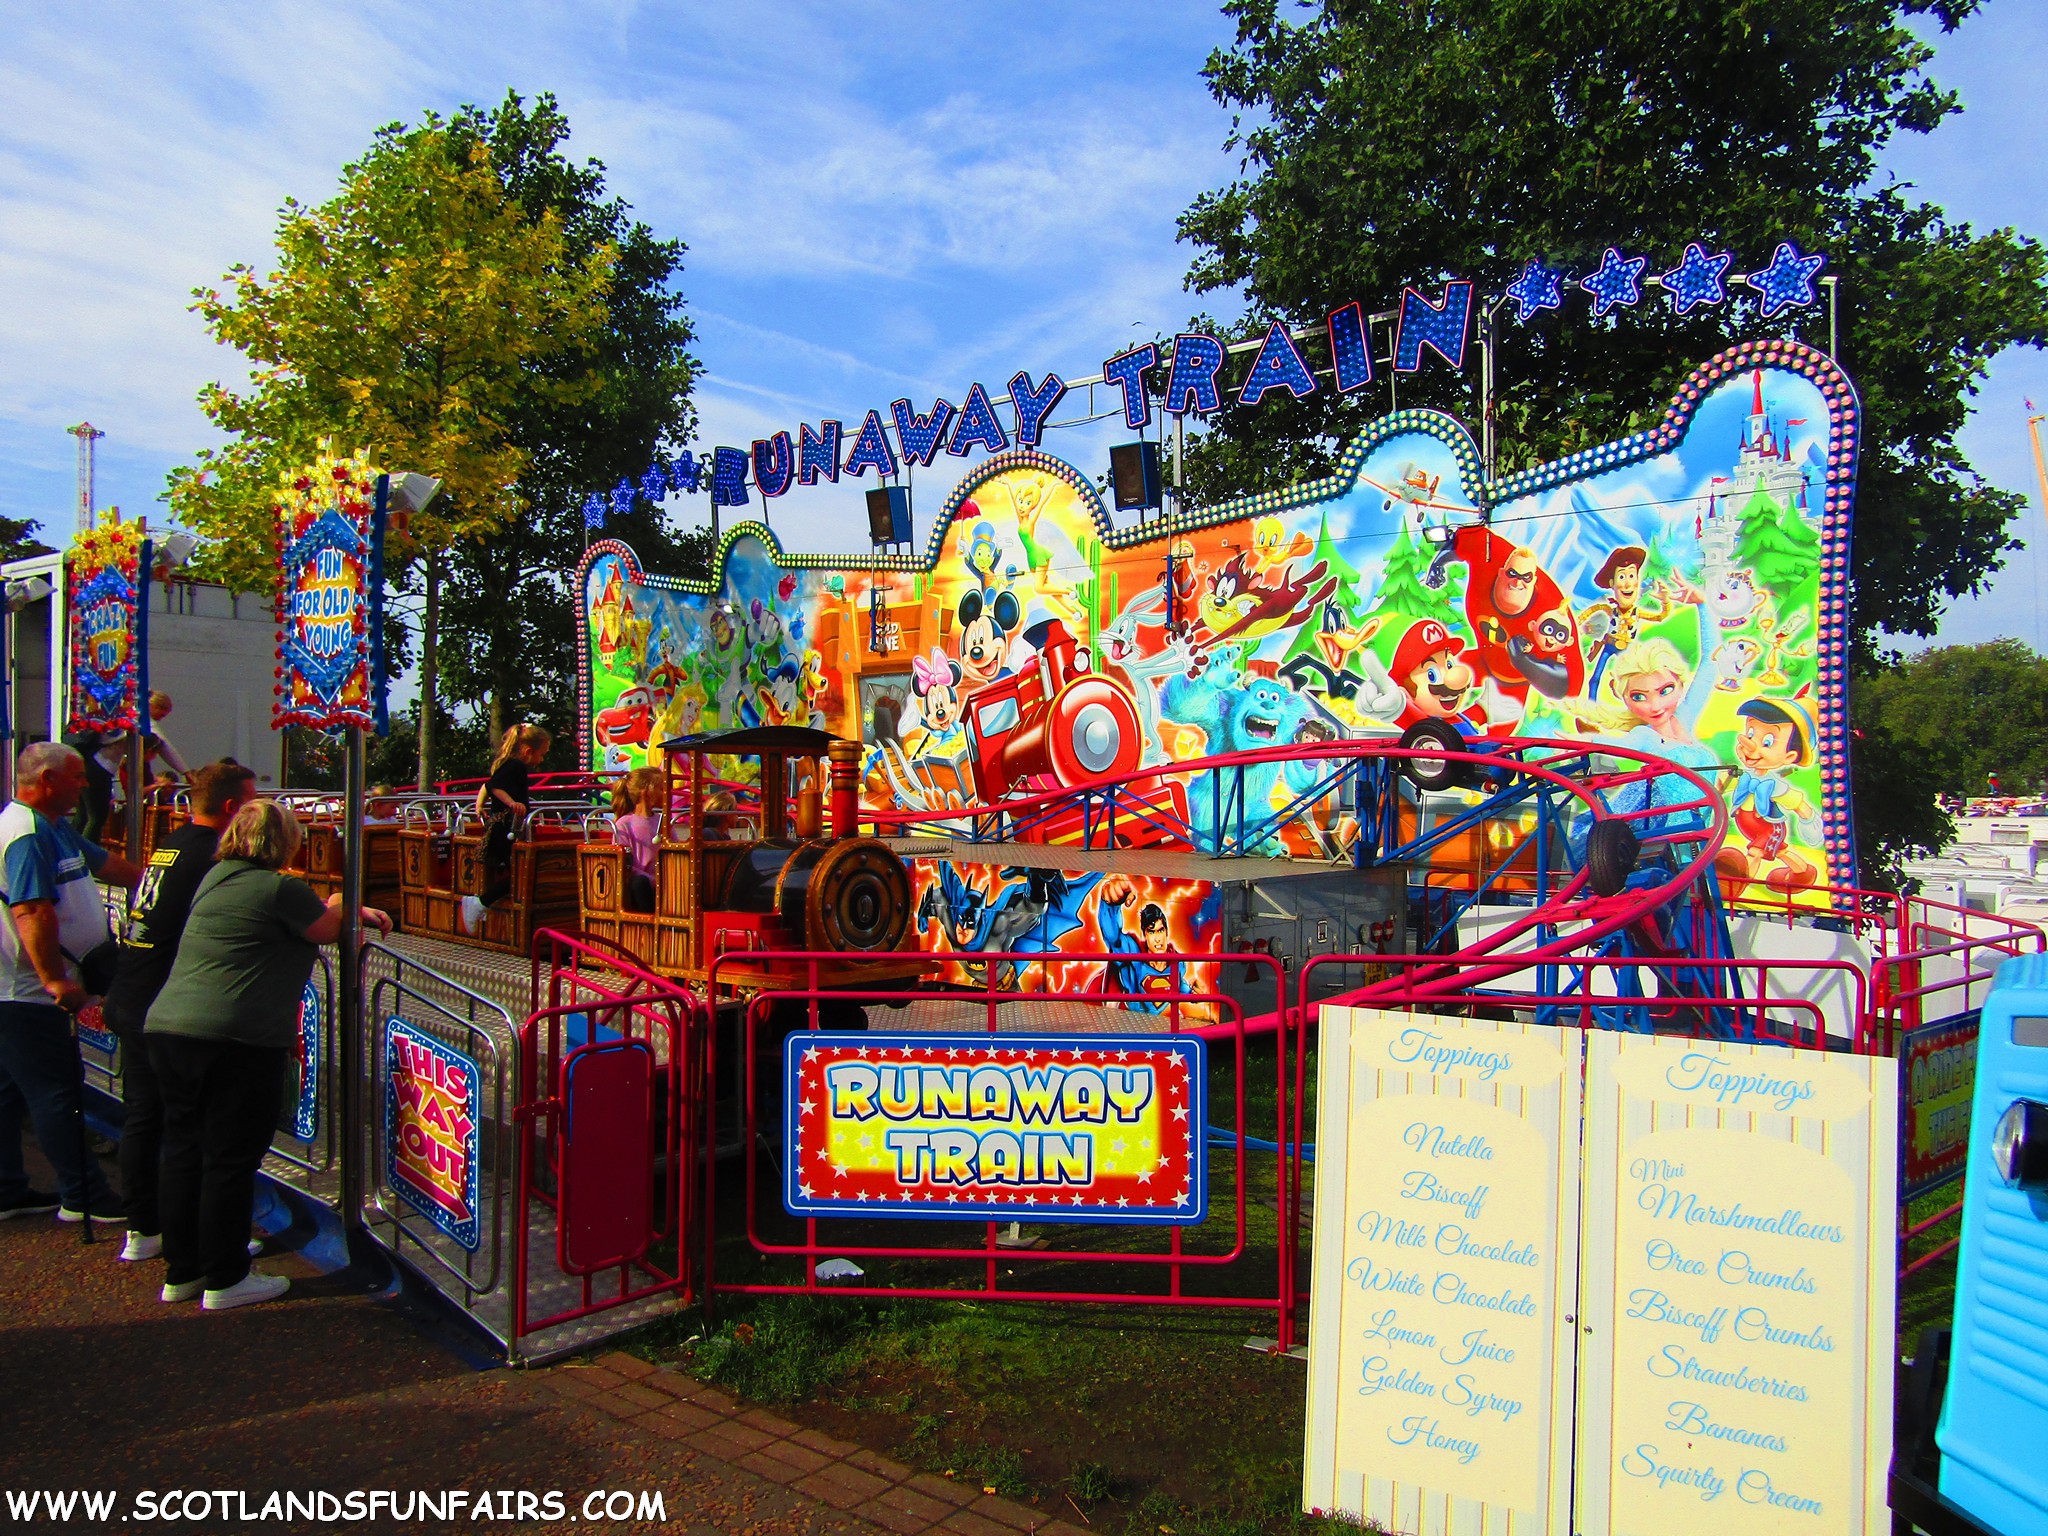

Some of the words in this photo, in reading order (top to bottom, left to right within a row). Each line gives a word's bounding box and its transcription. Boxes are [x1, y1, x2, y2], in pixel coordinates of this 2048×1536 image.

[711, 370, 1070, 506] RUNAWAY
[1103, 280, 1474, 431] TRAIN
[316, 545, 343, 582] FUN
[89, 599, 128, 637] CRAZY
[296, 588, 321, 618] FOR
[323, 585, 350, 618] OLD
[97, 638, 118, 671] FUN
[304, 619, 352, 657] YOUNG
[410, 848, 420, 877] 3
[462, 860, 475, 882] 2
[596, 868, 606, 897] 1
[392, 1031, 468, 1104] THIS
[1388, 1029, 1513, 1081] Toppings
[1666, 1053, 1816, 1110] Toppings
[391, 1071, 475, 1149] WAY
[827, 1065, 1154, 1125] RUNAWAY
[402, 1122, 464, 1187] OUT
[886, 1128, 1093, 1186] TRAIN
[1403, 1122, 1495, 1161] Nutella
[1400, 1171, 1489, 1220] Biscoff
[1630, 1158, 1686, 1183] Mini
[1357, 1211, 1427, 1250] Milk
[1434, 1224, 1539, 1268] Chocolate
[1637, 1183, 1845, 1244] Marshmallows
[1346, 1257, 1425, 1298] White
[1432, 1271, 1538, 1318] Chcoolate
[1645, 1239, 1708, 1276] Oreo
[1717, 1248, 1817, 1294] Crumbs
[1362, 1309, 1436, 1350] Lemon
[1441, 1329, 1515, 1365] Juice
[1626, 1288, 1727, 1344] Biscoff
[1733, 1305, 1835, 1352] Crumbs
[1358, 1355, 1436, 1397] Golden
[1442, 1374, 1522, 1422] Syrup
[1647, 1344, 1809, 1403] Strawberries
[1387, 1416, 1481, 1465] Honey
[1665, 1401, 1789, 1453] Bananas
[1621, 1444, 1726, 1502] Squirty
[1736, 1467, 1823, 1517] Cream
